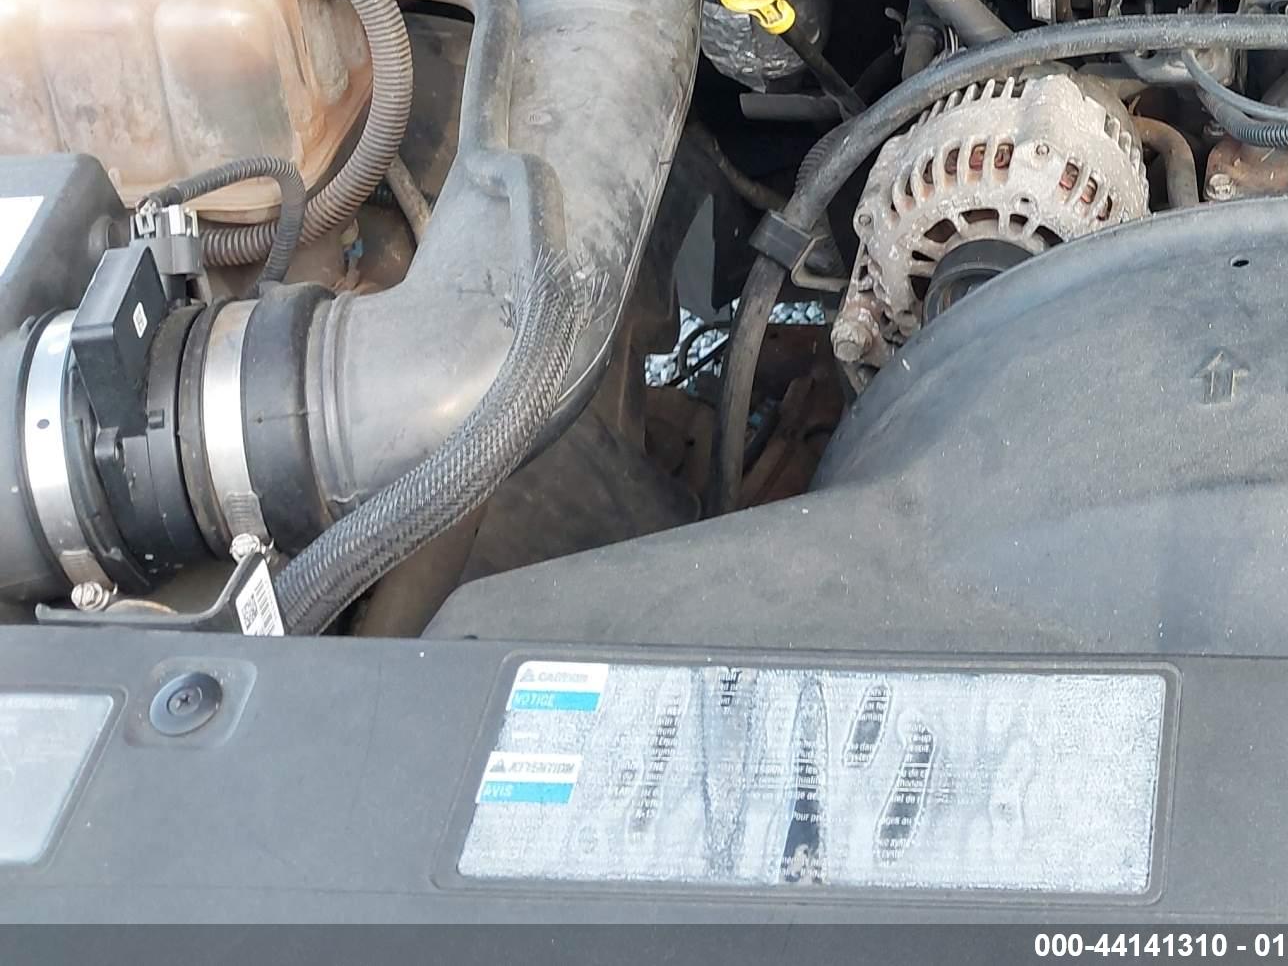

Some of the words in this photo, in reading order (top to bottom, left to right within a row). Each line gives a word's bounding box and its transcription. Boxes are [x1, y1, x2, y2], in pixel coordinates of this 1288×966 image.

[537, 672, 589, 684] CAUTION
[512, 693, 555, 707] NOTICE
[508, 760, 576, 775] ATTENTION
[482, 784, 514, 798] AVIS
